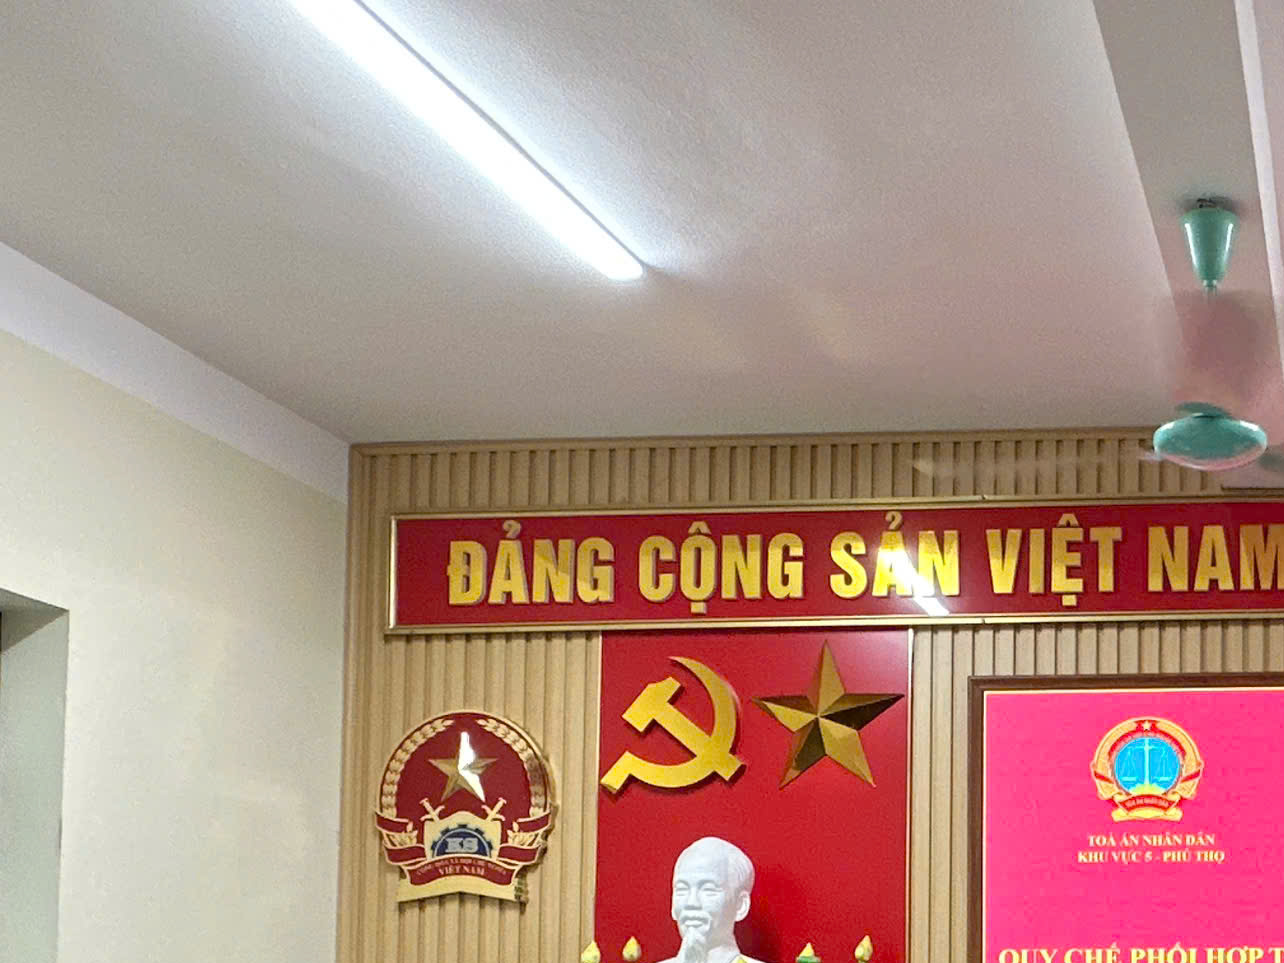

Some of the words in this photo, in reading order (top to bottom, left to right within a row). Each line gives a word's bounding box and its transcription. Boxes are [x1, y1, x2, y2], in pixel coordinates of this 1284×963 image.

[447, 520, 614, 605] ĐẢNG
[639, 521, 803, 613] CỘNG
[830, 511, 959, 598] SẢN
[986, 513, 1122, 606] VIỆT
[1077, 851, 1109, 863] KHU
[1196, 851, 1225, 864] THỌ
